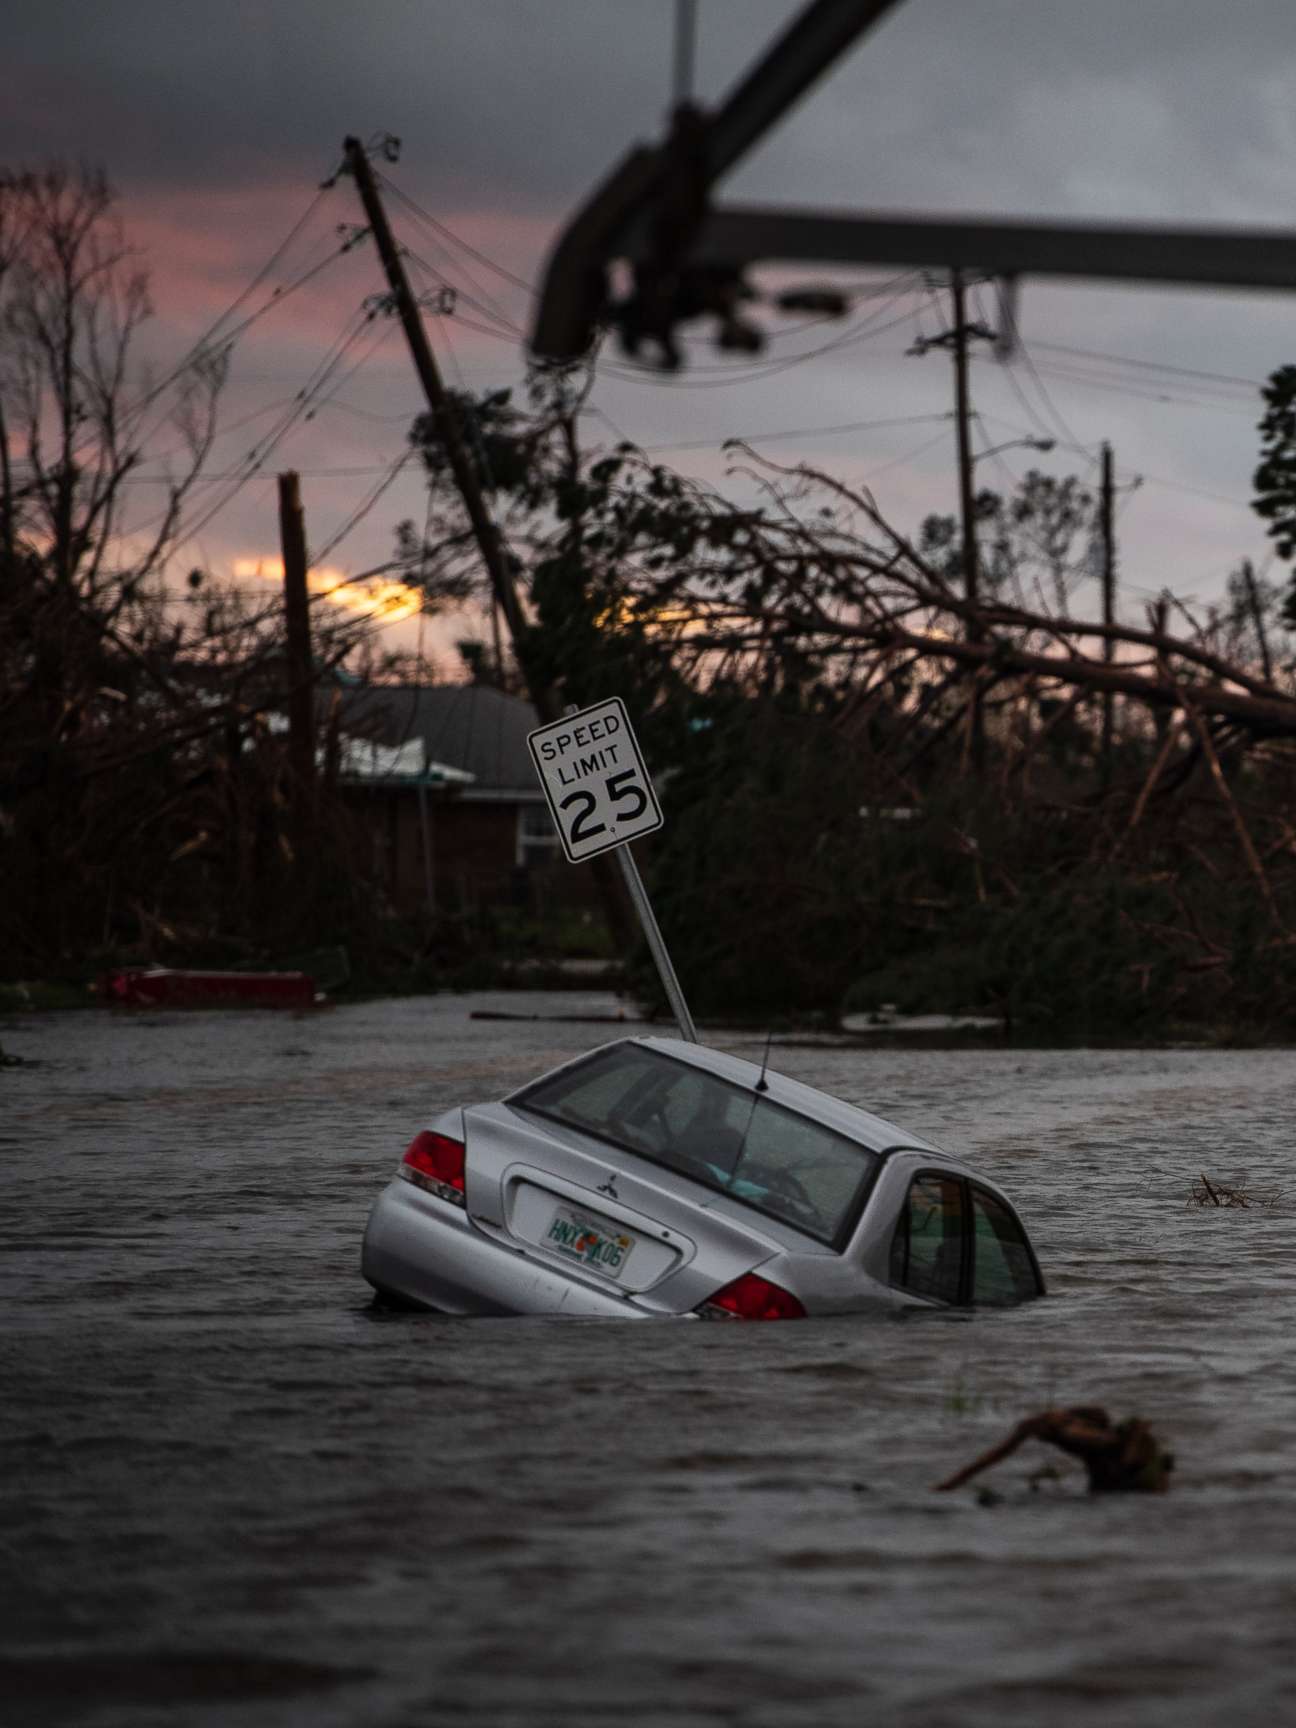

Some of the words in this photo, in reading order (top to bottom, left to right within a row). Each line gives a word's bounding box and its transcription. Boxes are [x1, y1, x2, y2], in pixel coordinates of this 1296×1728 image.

[540, 715, 620, 761] SPEED
[557, 744, 618, 785] LIMIT
[559, 768, 648, 844] 25
